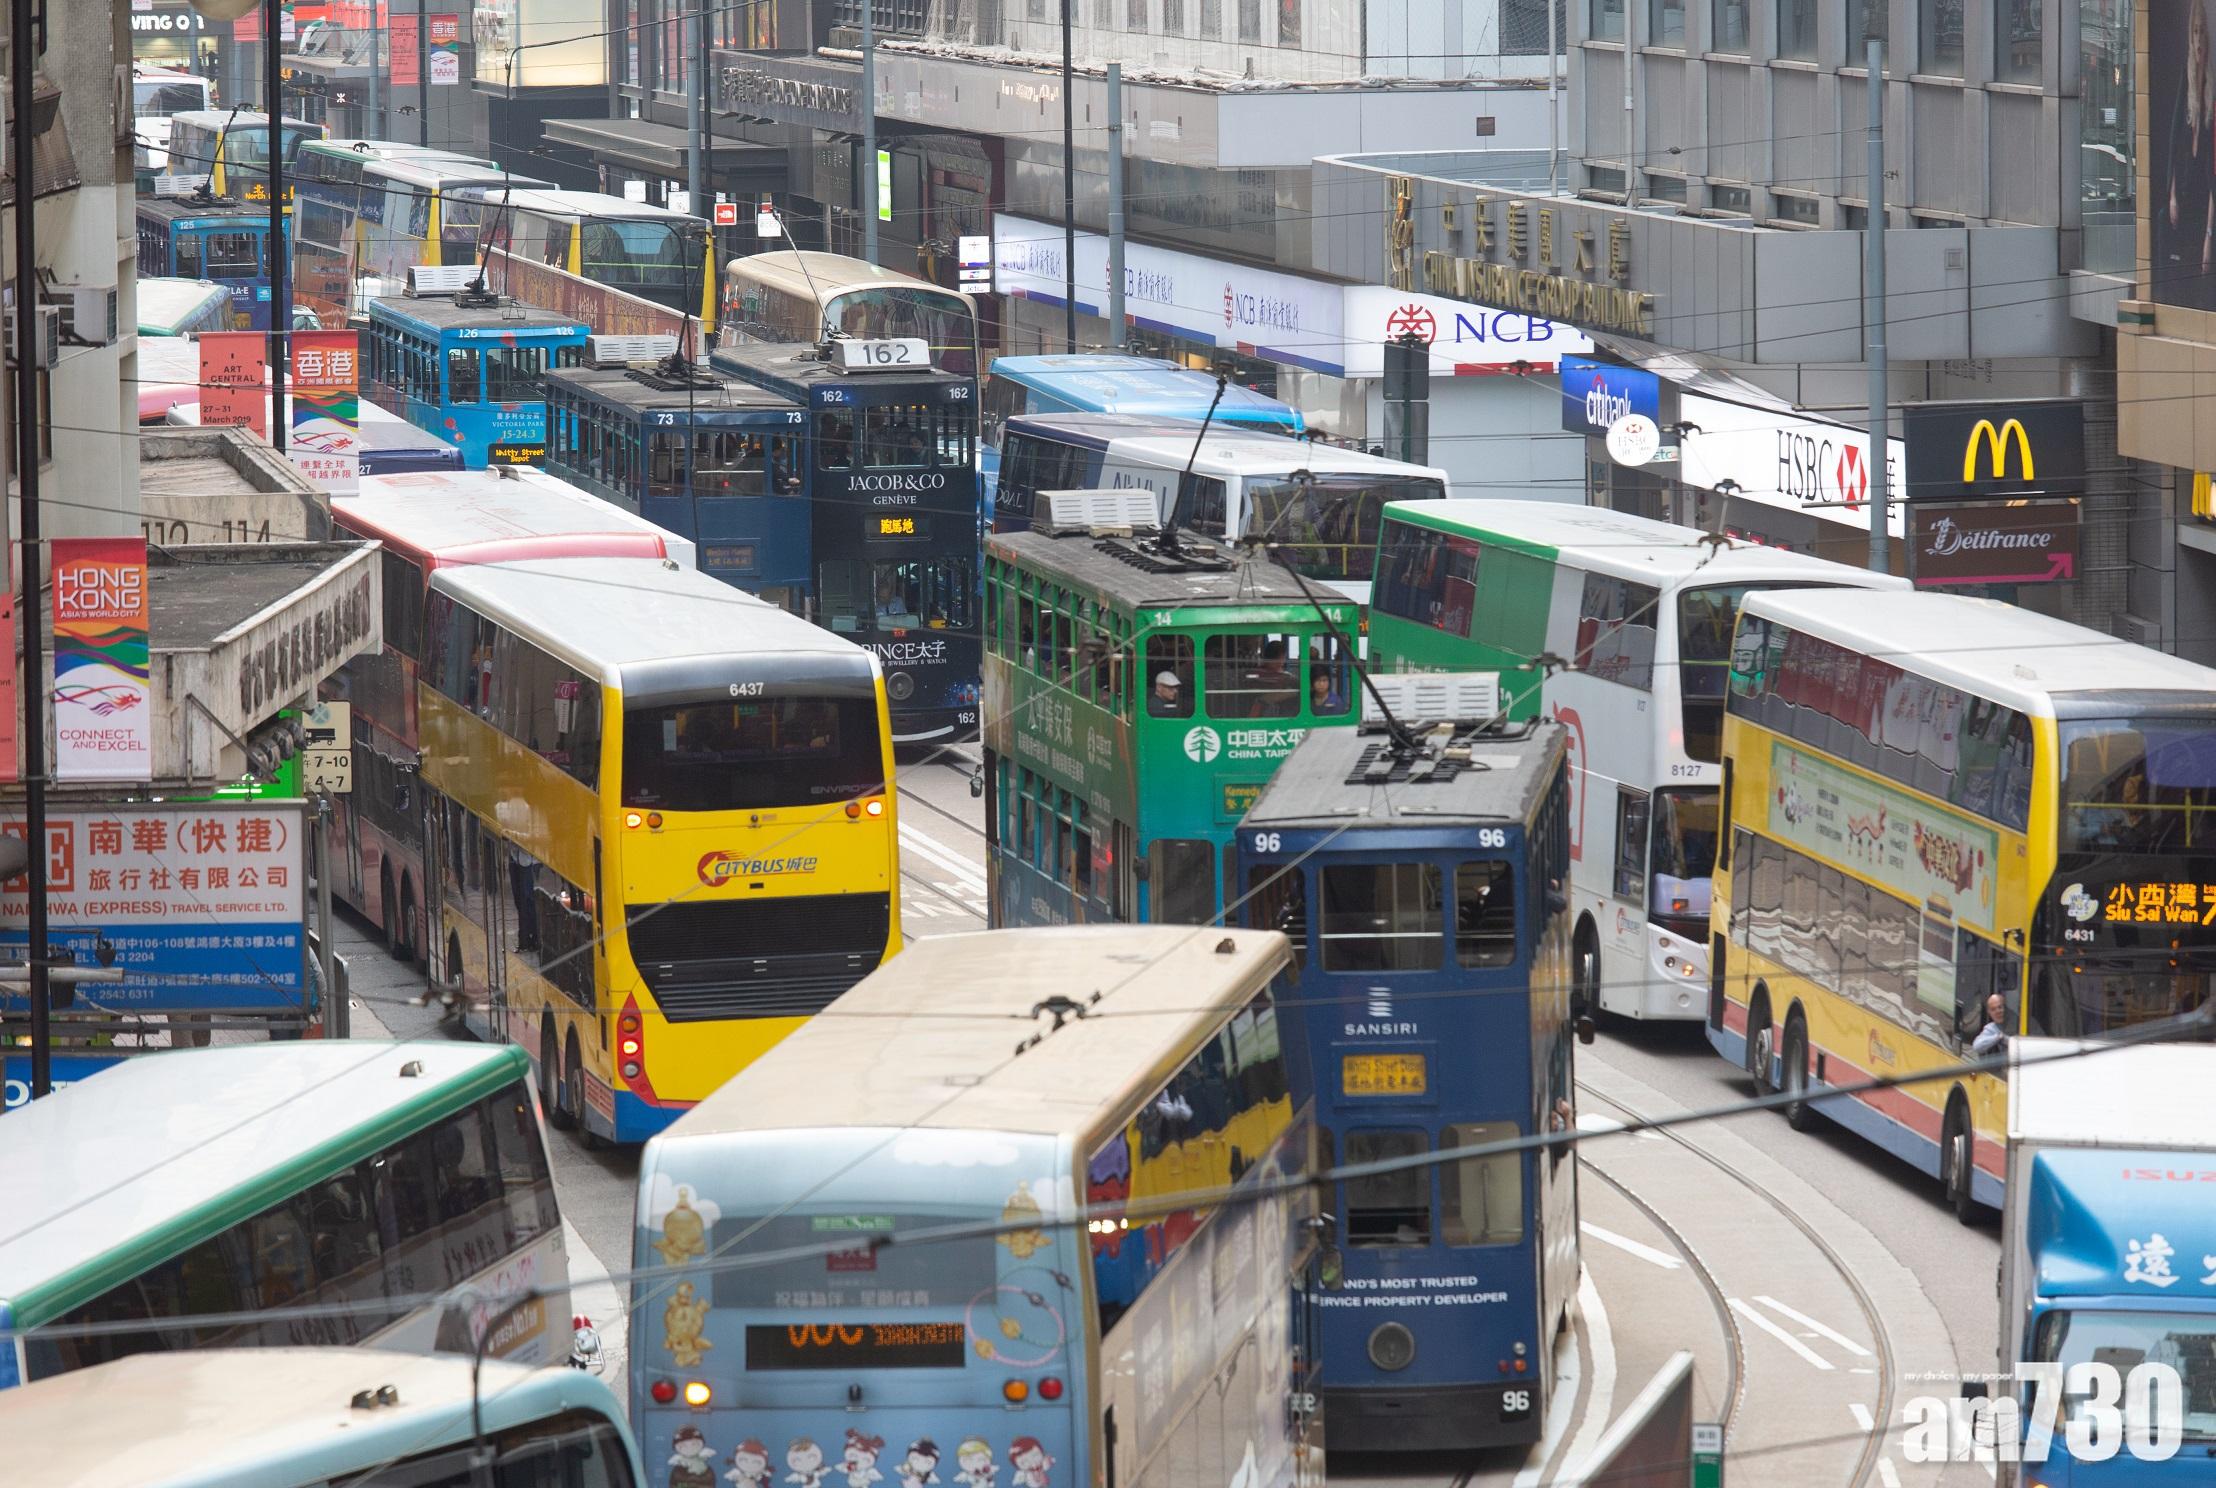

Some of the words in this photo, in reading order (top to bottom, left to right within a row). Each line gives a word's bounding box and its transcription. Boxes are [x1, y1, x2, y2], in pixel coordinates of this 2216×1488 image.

[433, 22, 457, 34] 香港
[180, 221, 195, 230] 125
[1124, 267, 1134, 297] CB
[1423, 250, 1465, 297] CHINA
[1465, 258, 1537, 311] INSURANCE
[1536, 272, 1582, 320] GROUP
[1583, 284, 1653, 336] BUILDING
[1235, 292, 1256, 325] NCB
[458, 329, 478, 338] 126
[556, 326, 575, 336] 126
[1455, 310, 1553, 344] NCB
[863, 343, 911, 365] 162
[223, 365, 243, 373] ART
[297, 351, 353, 377] 香港
[210, 375, 256, 383] CENTRAL
[821, 390, 843, 402] 162
[949, 387, 968, 399] 162
[203, 405, 213, 413] 27
[222, 405, 231, 413] 31
[203, 416, 231, 424] March
[232, 416, 252, 425] 2019
[657, 413, 674, 425] 73
[786, 412, 802, 424] 73
[502, 429, 537, 440] 15-24.3
[495, 449, 518, 458] Whitty
[522, 448, 545, 456] Street
[511, 455, 530, 463] Depot
[1776, 429, 1833, 502] HSBC
[848, 473, 945, 492] JACOB&CO
[873, 493, 917, 505] GENÈVE
[222, 519, 270, 544] 114
[880, 518, 914, 534] 跑馬地
[1925, 516, 2051, 556] Délifrance
[59, 567, 141, 588] HONG
[59, 589, 141, 610] KONG
[60, 610, 89, 618] ASIA'S
[88, 610, 118, 618] WORLD
[118, 610, 141, 618] CITY
[1154, 611, 1172, 626] 14
[1325, 608, 1342, 623] 14
[861, 643, 919, 660] RINCE
[914, 640, 946, 658] 太子
[729, 682, 764, 697] 6437
[958, 712, 975, 724] 162
[60, 729, 135, 741] CONNECT
[1227, 728, 1306, 747] 中国太平
[72, 741, 97, 750] AND
[97, 740, 147, 752] EXCEL
[1227, 749, 1262, 759] CHINA
[1263, 749, 1290, 758] TAIP
[1671, 765, 1702, 777] 8127
[1255, 833, 1281, 852] 96
[1479, 828, 1505, 848] 96
[715, 858, 785, 876] CITYBUS
[785, 857, 818, 872] 城巴
[89, 866, 288, 891] 旅行社有限公司
[2108, 882, 2198, 907] 小西灣
[2, 903, 30, 917] NA
[84, 901, 168, 917] (EXPRESS)
[172, 903, 210, 913] TRAVEL
[215, 903, 262, 913] SERVICE
[265, 903, 288, 913] LTD.
[2105, 904, 2131, 921] Siu
[2134, 904, 2161, 922] Sai
[2164, 905, 2199, 922] Wan
[2064, 929, 2094, 942] 6431
[74, 952, 89, 963] EL
[128, 952, 155, 962] 2204
[99, 989, 126, 1000] 2543
[128, 988, 154, 999] 6311
[1344, 1022, 1418, 1036] SANSIRI
[1380, 1276, 1417, 1289] MOST
[1420, 1275, 1478, 1288] TRUSTED
[1364, 1295, 1432, 1307] PROPERTY
[1434, 1292, 1509, 1306] DEVELOPER
[1503, 1390, 1530, 1412] 96
